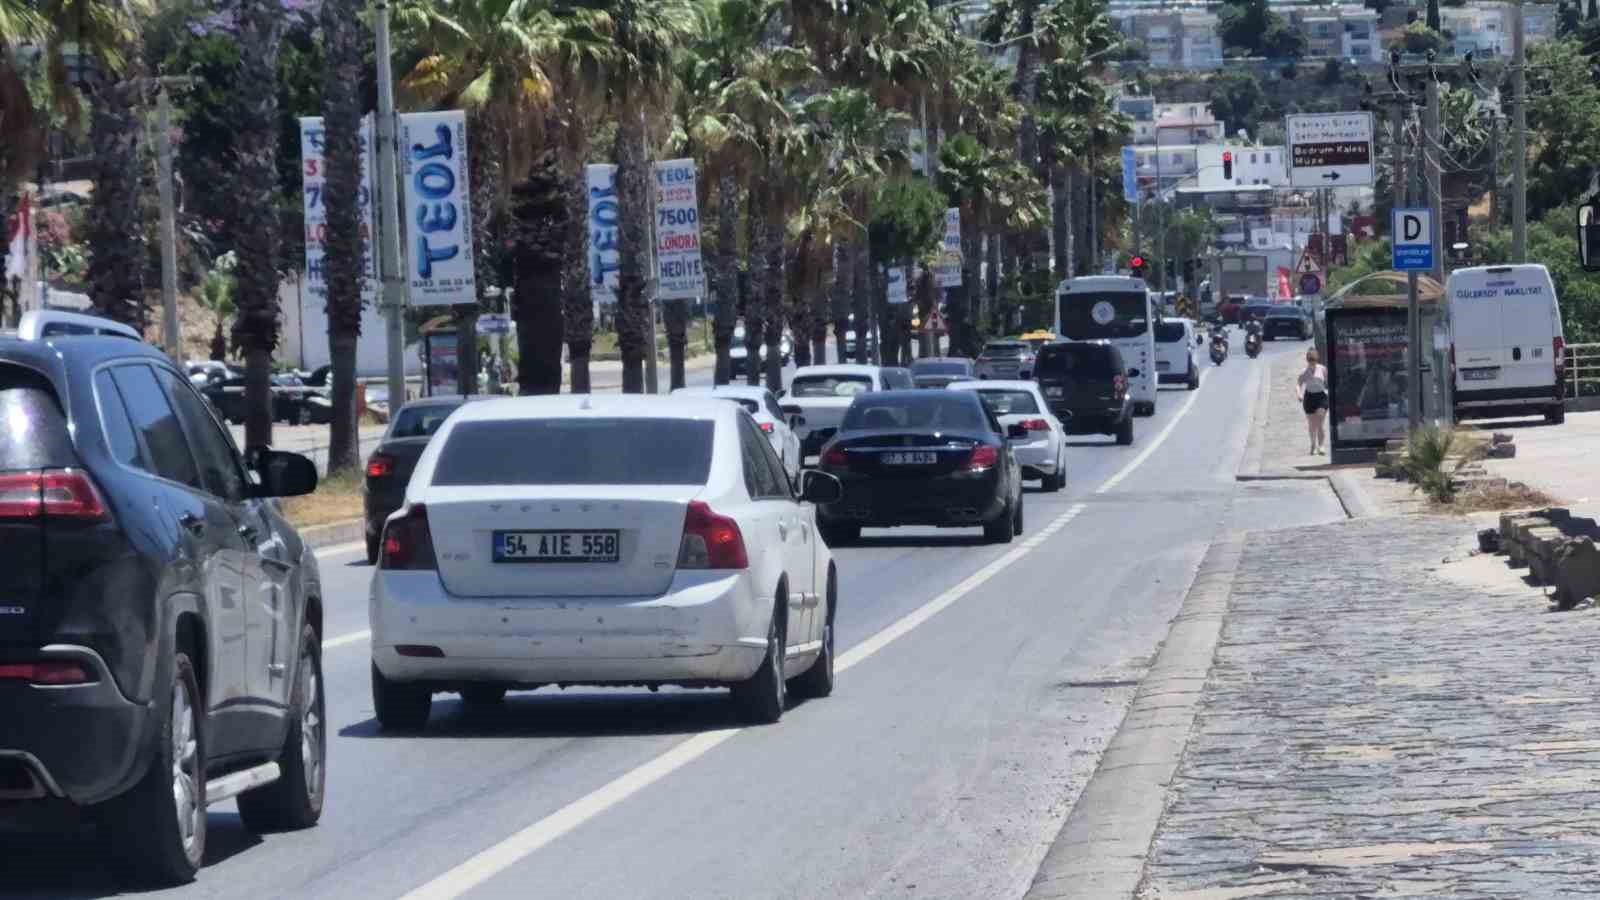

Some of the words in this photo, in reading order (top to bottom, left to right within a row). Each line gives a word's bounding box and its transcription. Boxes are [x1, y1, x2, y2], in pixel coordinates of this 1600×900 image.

[1295, 146, 1334, 155] Bodrum
[1336, 145, 1366, 153] Kalesi
[657, 166, 694, 185] TEOL
[412, 122, 458, 280] TEOL
[658, 207, 697, 227] 7500
[1403, 214, 1422, 241] D
[658, 233, 698, 251] LONDRA
[660, 255, 701, 278] HEDİYE
[505, 535, 527, 556] 54
[538, 535, 571, 555] AIE
[582, 534, 616, 555] 558
